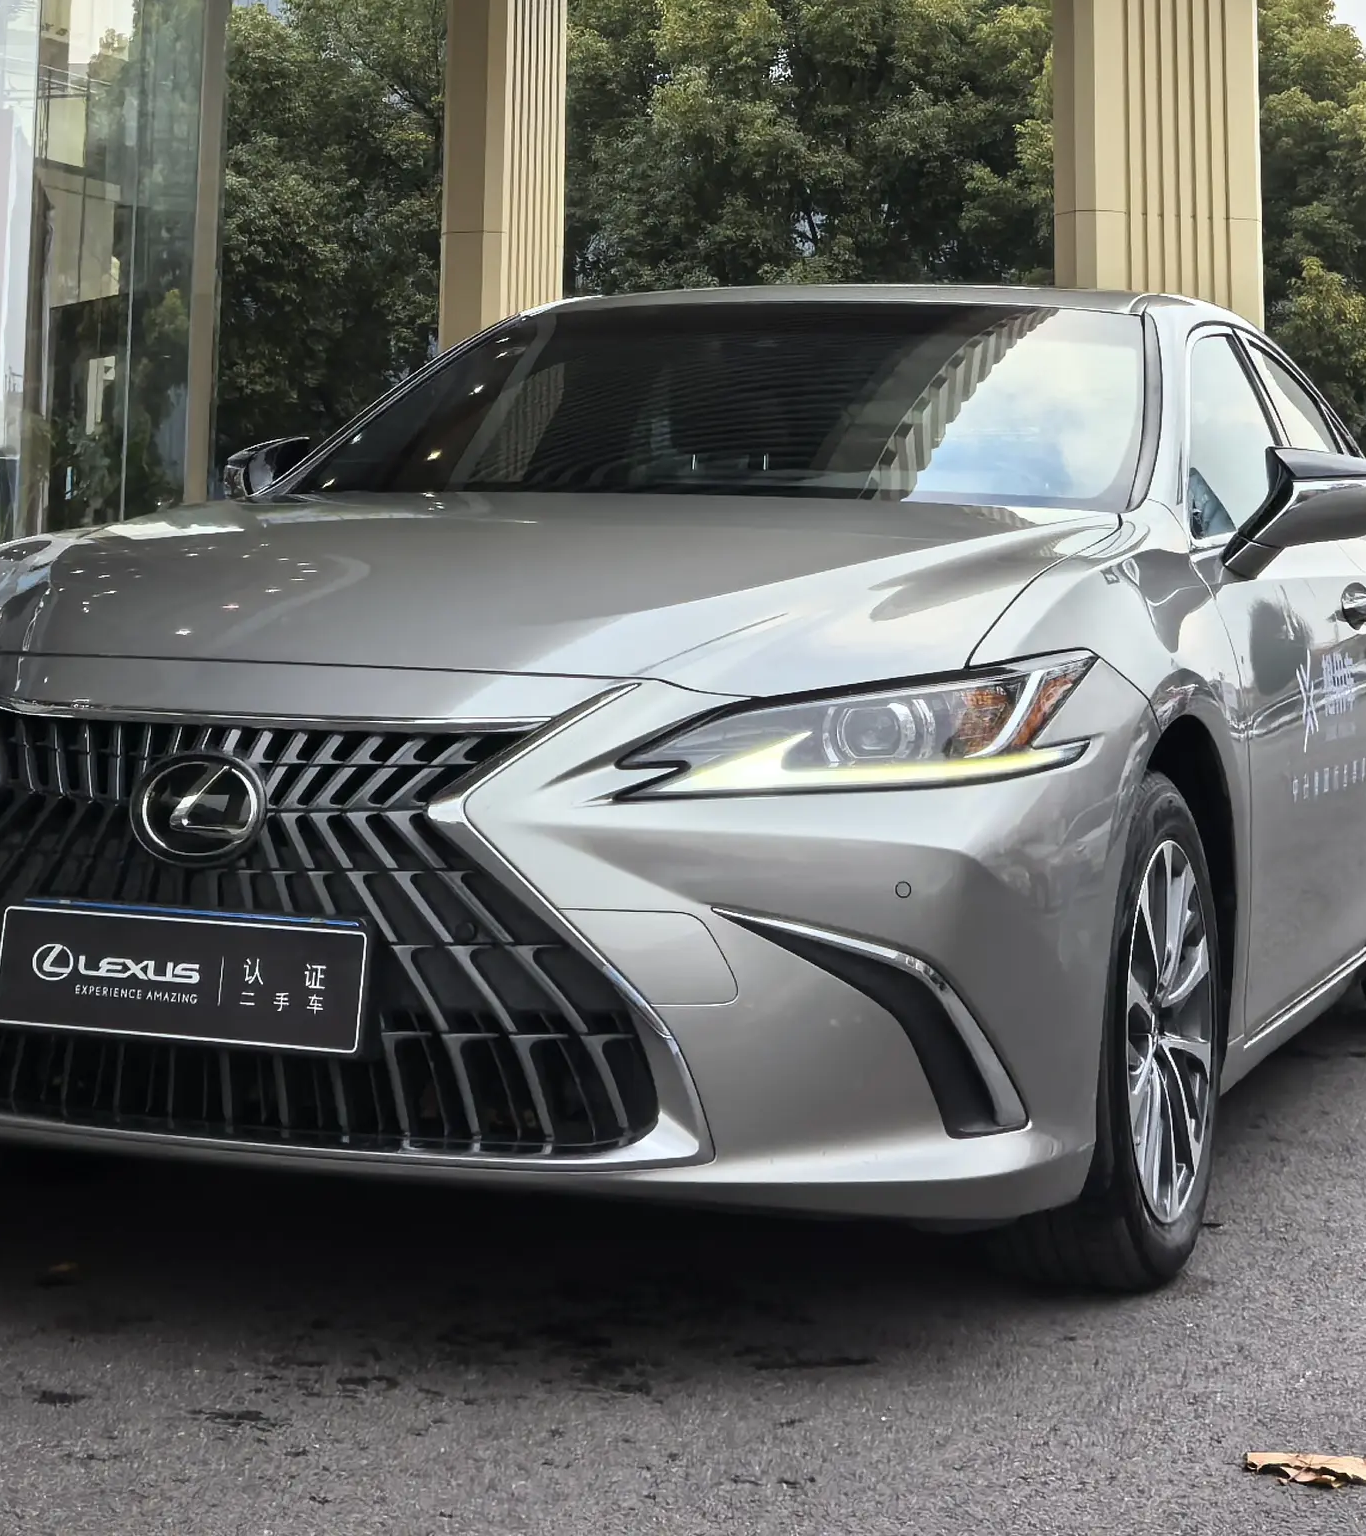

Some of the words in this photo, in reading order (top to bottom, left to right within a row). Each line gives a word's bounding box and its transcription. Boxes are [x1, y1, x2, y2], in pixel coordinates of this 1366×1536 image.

[79, 955, 200, 984] LEXUS
[243, 958, 327, 990] 认证
[75, 984, 143, 1000] EXPERIENCE
[146, 990, 199, 1005] AMAZING
[239, 992, 324, 1014] 二手车
